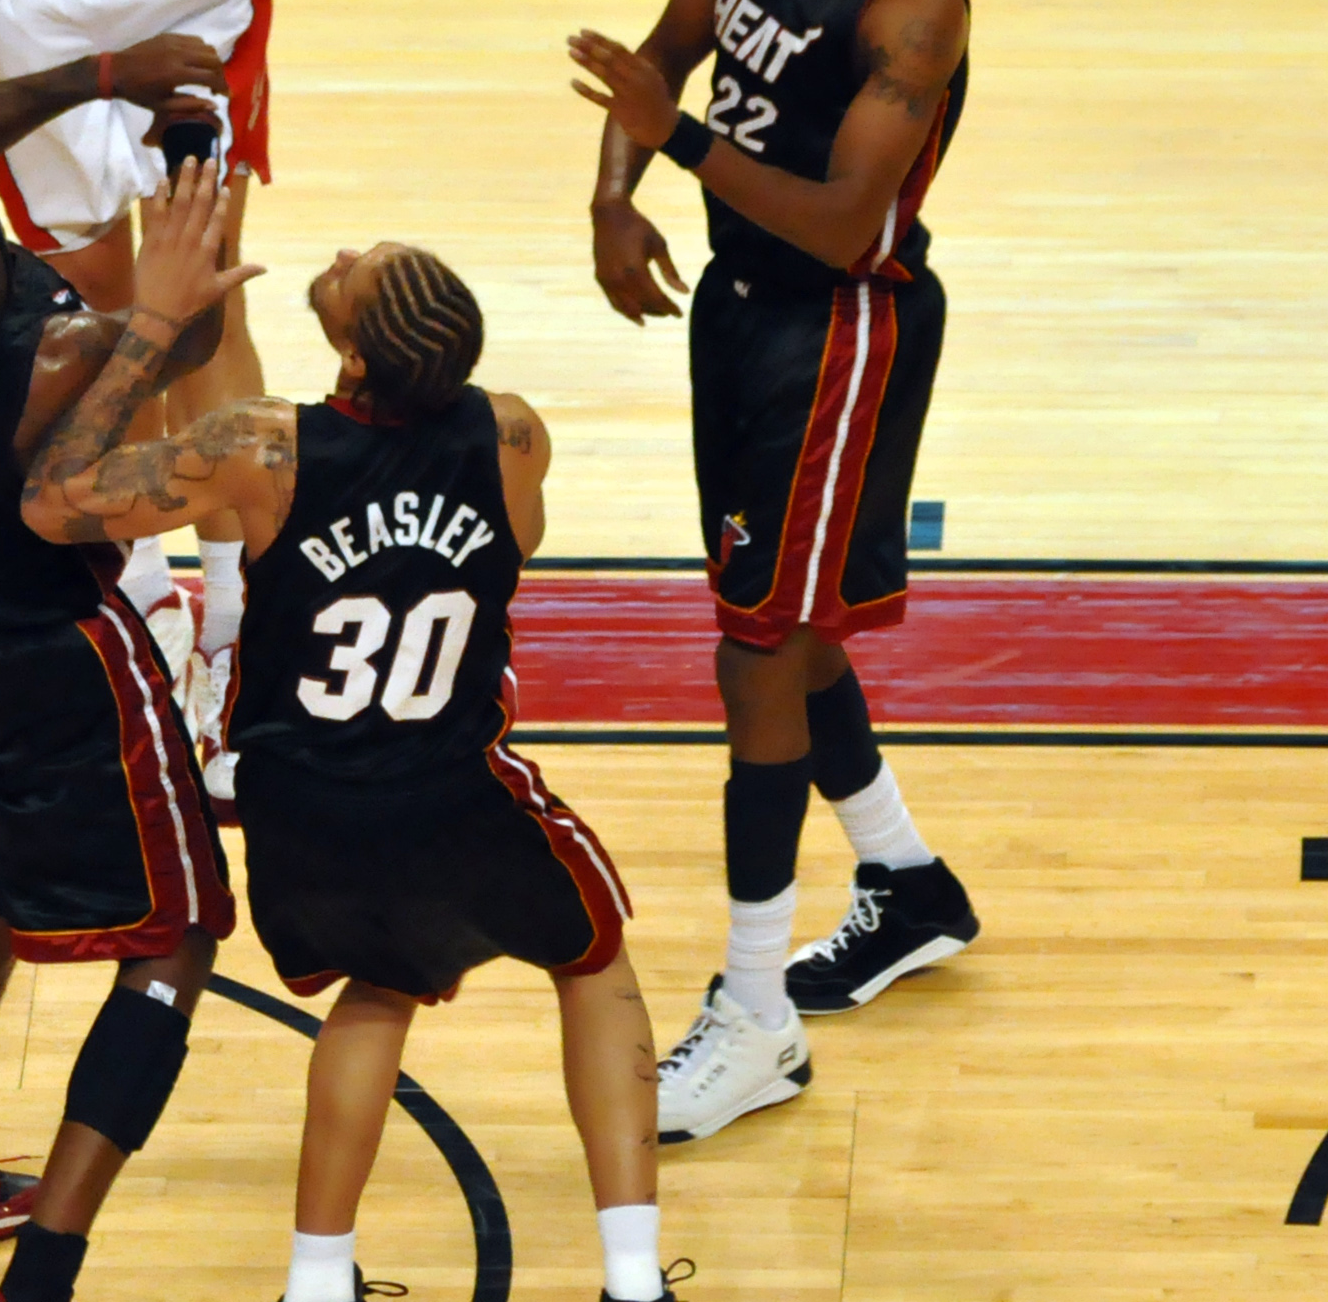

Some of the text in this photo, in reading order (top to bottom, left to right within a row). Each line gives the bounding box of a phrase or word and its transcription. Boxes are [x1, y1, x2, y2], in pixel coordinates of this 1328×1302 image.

[706, 75, 779, 153] 22
[299, 491, 495, 582] BEASLEY
[296, 590, 477, 721] 30
